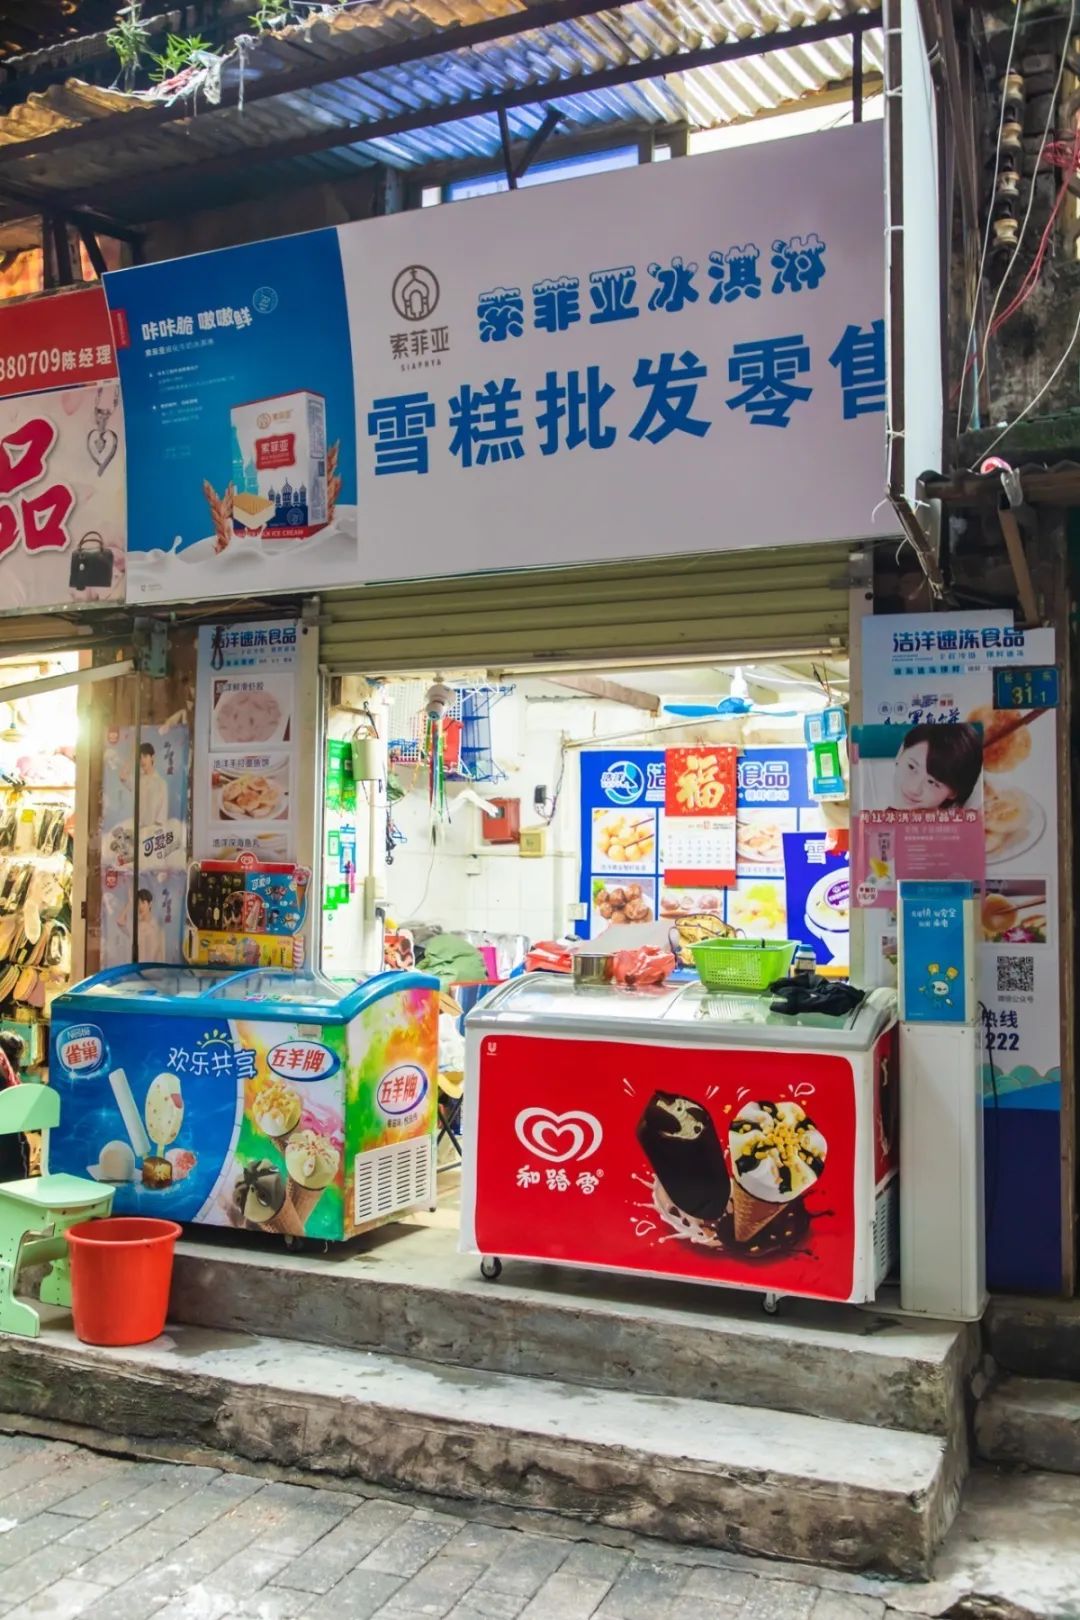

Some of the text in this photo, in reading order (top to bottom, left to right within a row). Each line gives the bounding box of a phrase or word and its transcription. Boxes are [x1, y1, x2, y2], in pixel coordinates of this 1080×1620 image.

[477, 233, 827, 343] 索菲亚冰淇淋
[141, 316, 194, 341] 咔咔脆
[390, 325, 450, 360] 索菲亚
[367, 319, 886, 476] 雪糕批发零售
[675, 754, 725, 809] 福
[66, 1040, 98, 1065] 雀巢
[167, 1047, 258, 1079] 欢乐共享
[271, 1048, 326, 1074] 五羊牌
[381, 1074, 418, 1104] 五羊牌
[516, 1164, 600, 1195] 和路雪
